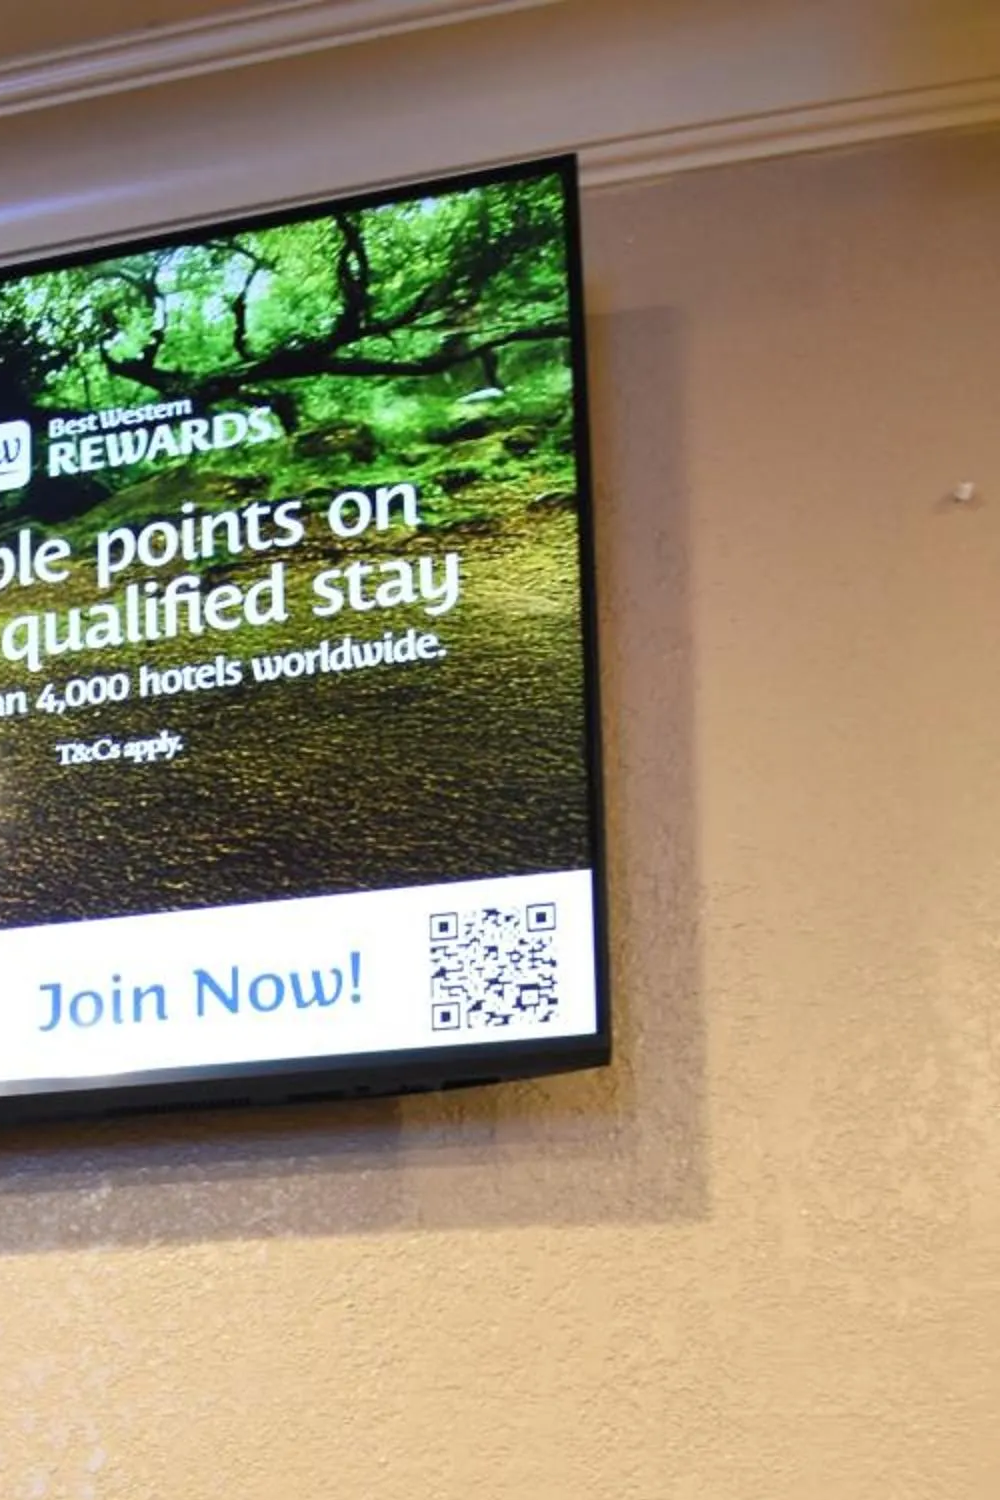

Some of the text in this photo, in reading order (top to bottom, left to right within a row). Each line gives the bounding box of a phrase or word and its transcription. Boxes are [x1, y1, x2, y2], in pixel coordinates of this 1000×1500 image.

[49, 399, 192, 439] Best Western
[95, 498, 304, 588] points
[327, 482, 419, 539] on
[1, 562, 288, 672] qualified
[311, 551, 461, 616] stay
[36, 674, 131, 716] 4,000
[138, 653, 242, 698] hotels
[252, 629, 447, 682] worldwide.
[37, 950, 362, 1032] Join Now!
